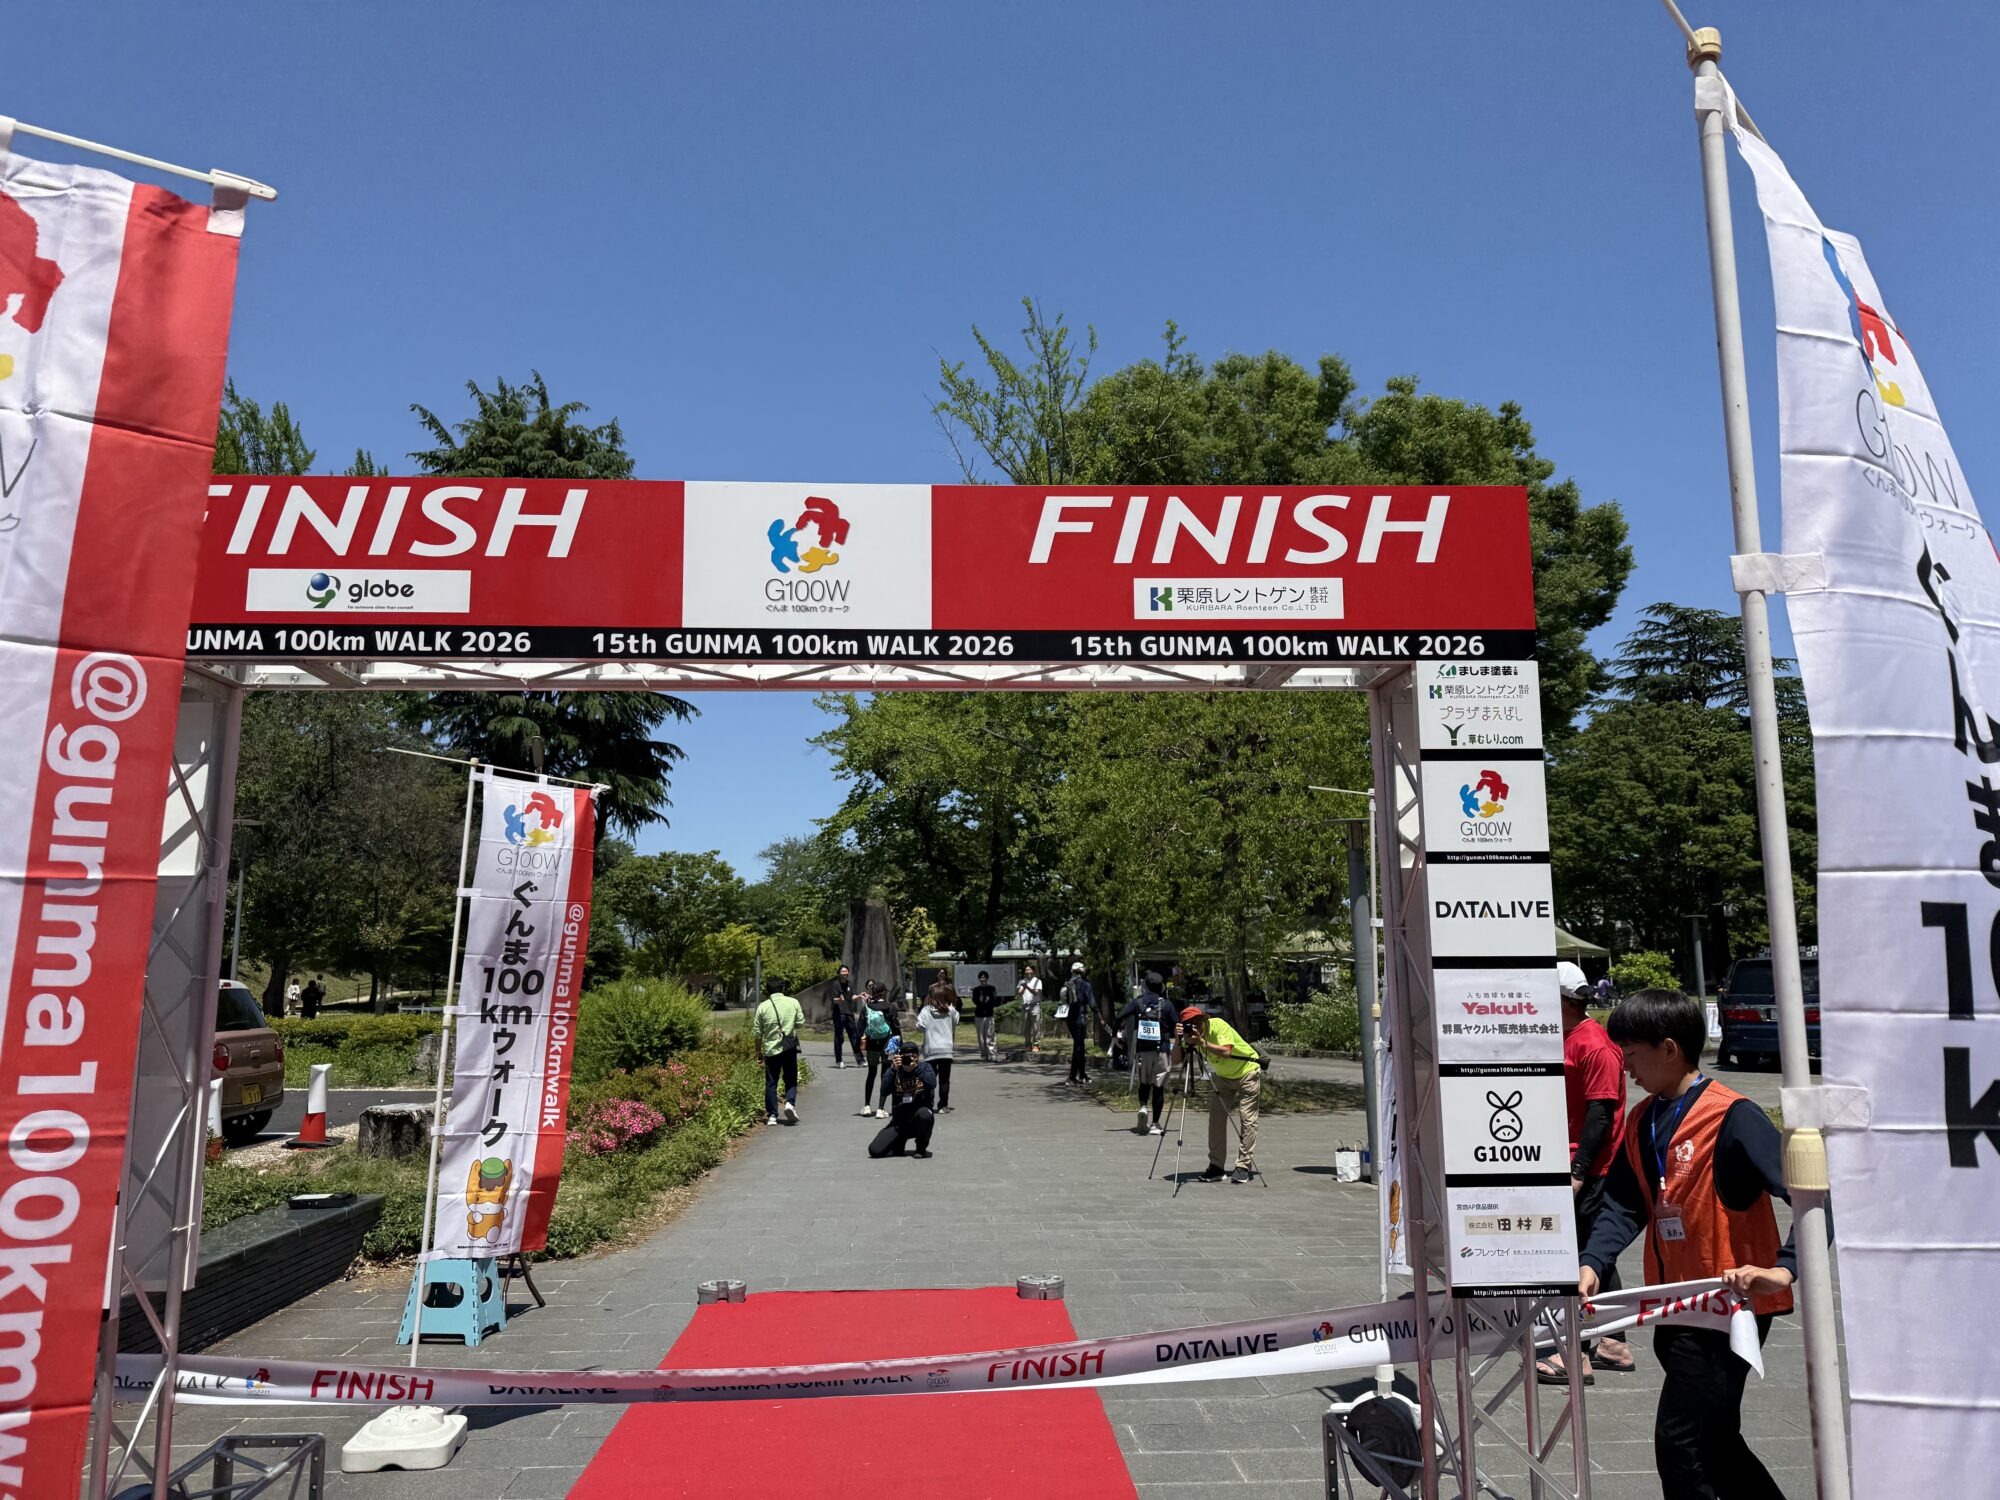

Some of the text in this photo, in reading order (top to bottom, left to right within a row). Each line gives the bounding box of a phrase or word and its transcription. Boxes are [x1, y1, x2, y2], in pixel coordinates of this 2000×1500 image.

[1028, 495, 1451, 564] FINISH
[1918, 510, 1976, 540] ウォーク
[348, 579, 415, 603] globe
[765, 578, 850, 602] G100W
[1177, 586, 1305, 604] 栗原レントゲン
[765, 604, 850, 613] ぐんま 100km ウォーク
[1236, 604, 1278, 612] Roentgen
[186, 629, 532, 653] UNMA 100km WALK 2026
[593, 632, 1014, 657] 15th GUNMA 100km WALK 2026
[1070, 635, 1485, 657] 15th GUNMA 100km WALK 2026
[1444, 684, 1517, 695] 栗原レントゲン
[1440, 706, 1523, 721] プラザまえばし
[1468, 733, 1524, 744] 草むしり.com
[1460, 821, 1512, 836] G100W
[497, 848, 562, 870] G100W
[1447, 854, 1532, 862] http://gunma100kmwalk.com
[1436, 900, 1550, 918] DATALIVE
[542, 904, 585, 1128] @gunma100kmwalk
[1461, 1002, 1538, 1015] Yakult
[1442, 1023, 1560, 1035] 群馬ヤクルト販売株式会社
[0, 651, 148, 1500] @gunma100kmw
[1460, 1066, 1546, 1074] http://gunma100kmwalk.com
[1474, 1145, 1541, 1162] G100W
[1474, 1248, 1511, 1257] フレッセイ
[1473, 1288, 1561, 1296] http://gunma100kmwalk.com
[1156, 1332, 1279, 1362] DATALIVE
[988, 1349, 1105, 1383] FINISH
[311, 1370, 434, 1400] FINISH
